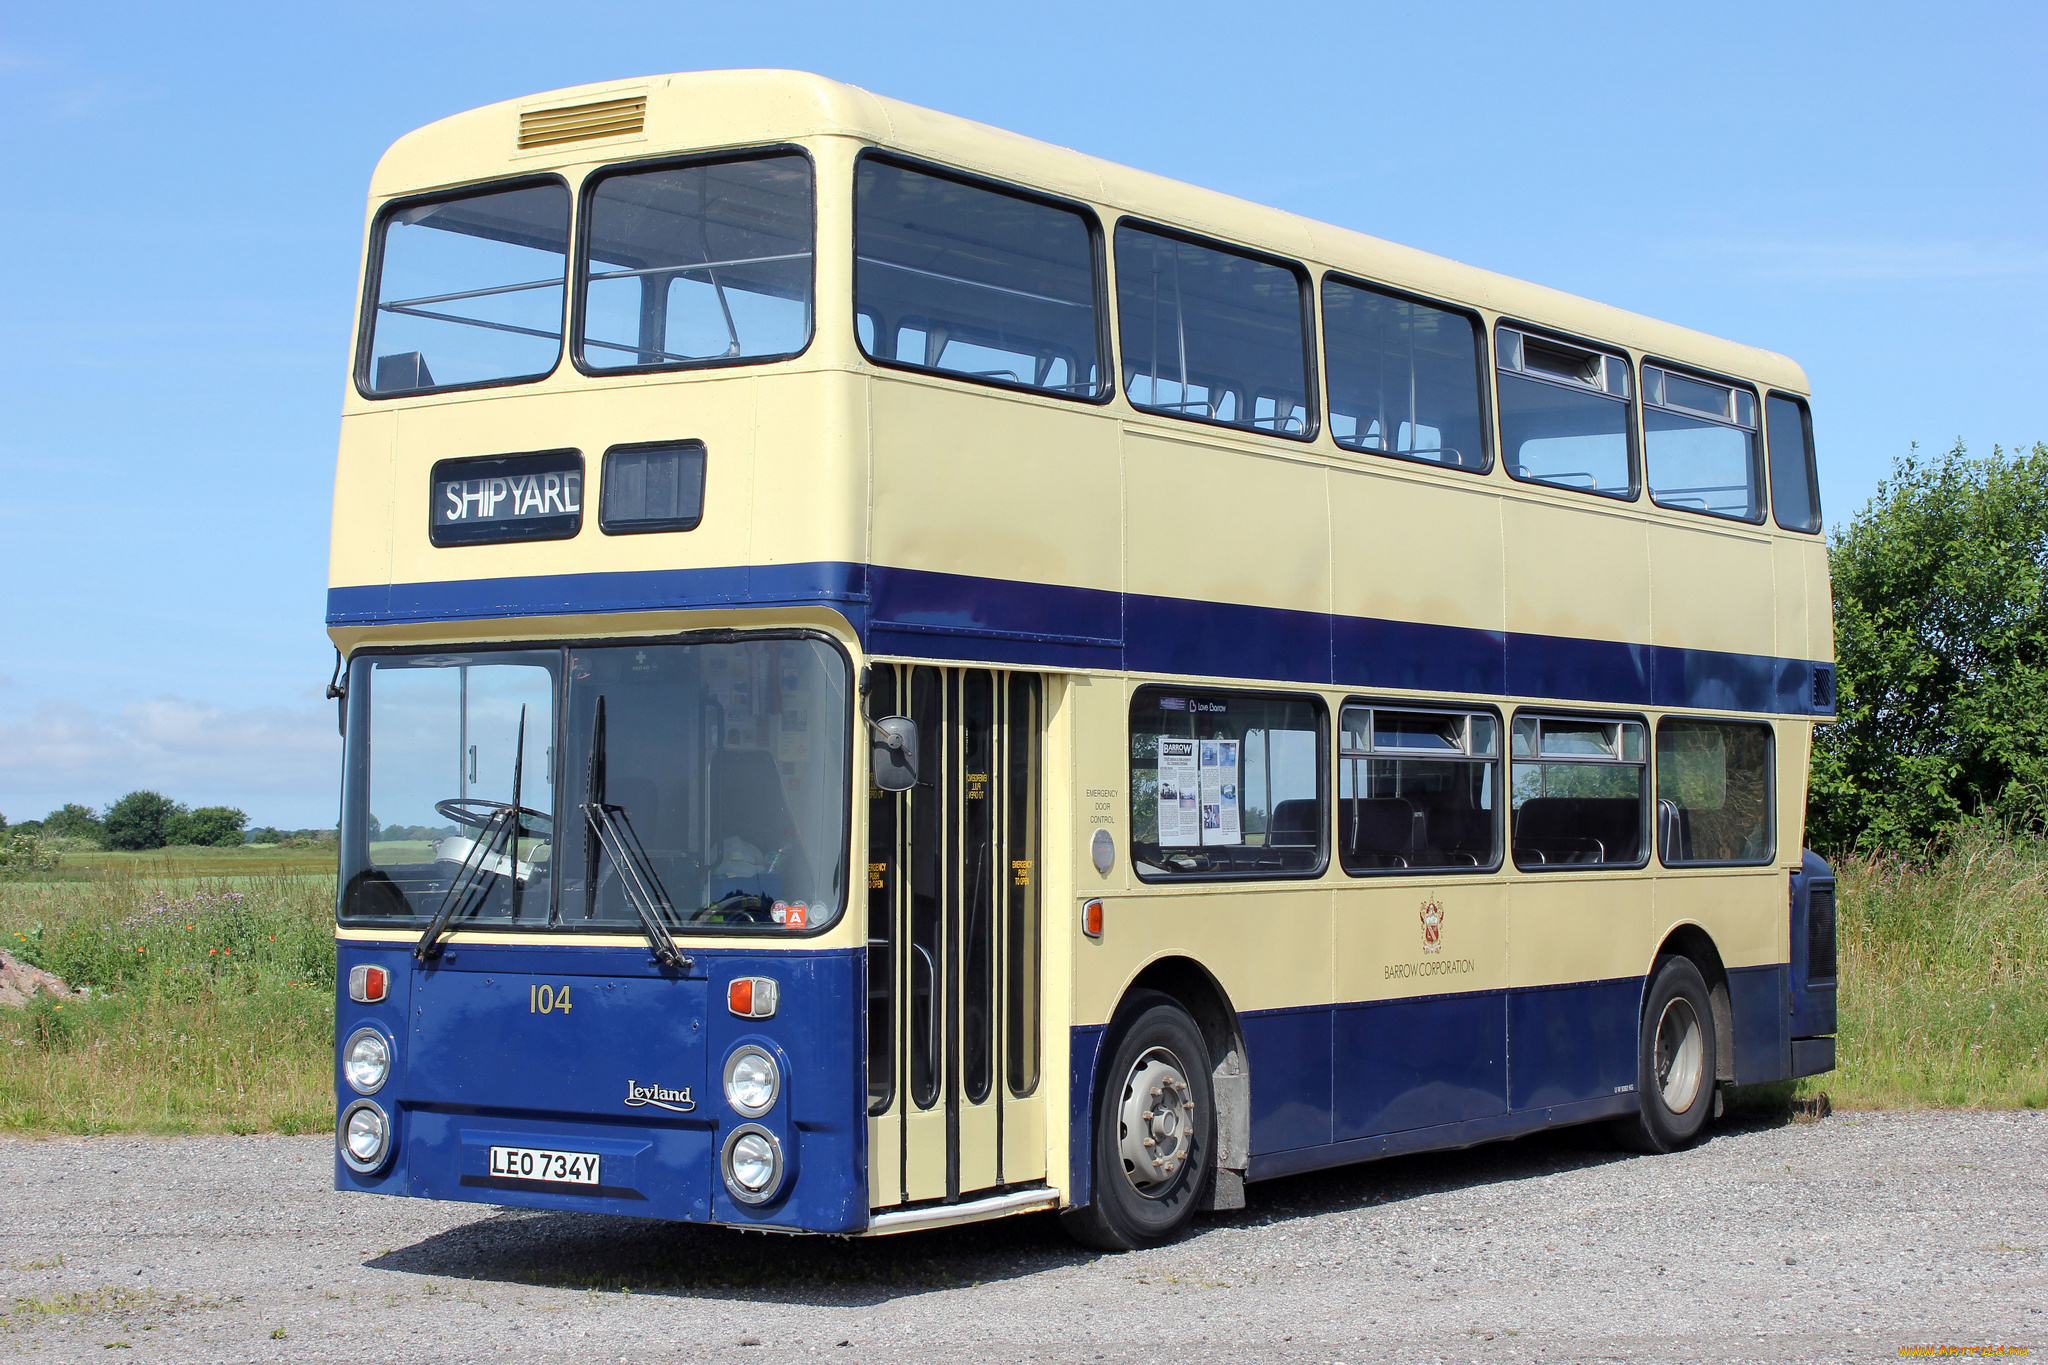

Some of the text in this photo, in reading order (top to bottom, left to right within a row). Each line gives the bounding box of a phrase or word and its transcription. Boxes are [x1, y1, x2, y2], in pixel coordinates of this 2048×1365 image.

[446, 472, 580, 521] SHIPYARD
[1197, 702, 1209, 711] Love
[1163, 743, 1192, 755] BARROW
[1086, 789, 1119, 798] EMERGENCY
[1095, 802, 1111, 811] DOOR
[1090, 815, 1115, 824] CONTROL
[1012, 861, 1033, 869] EMERGENCY
[790, 912, 802, 923] A
[1384, 959, 1475, 980] BARROW CORPORATION
[530, 984, 573, 1015] 104
[625, 1079, 695, 1109] Leyland
[492, 1150, 597, 1181] LEO 734Y
